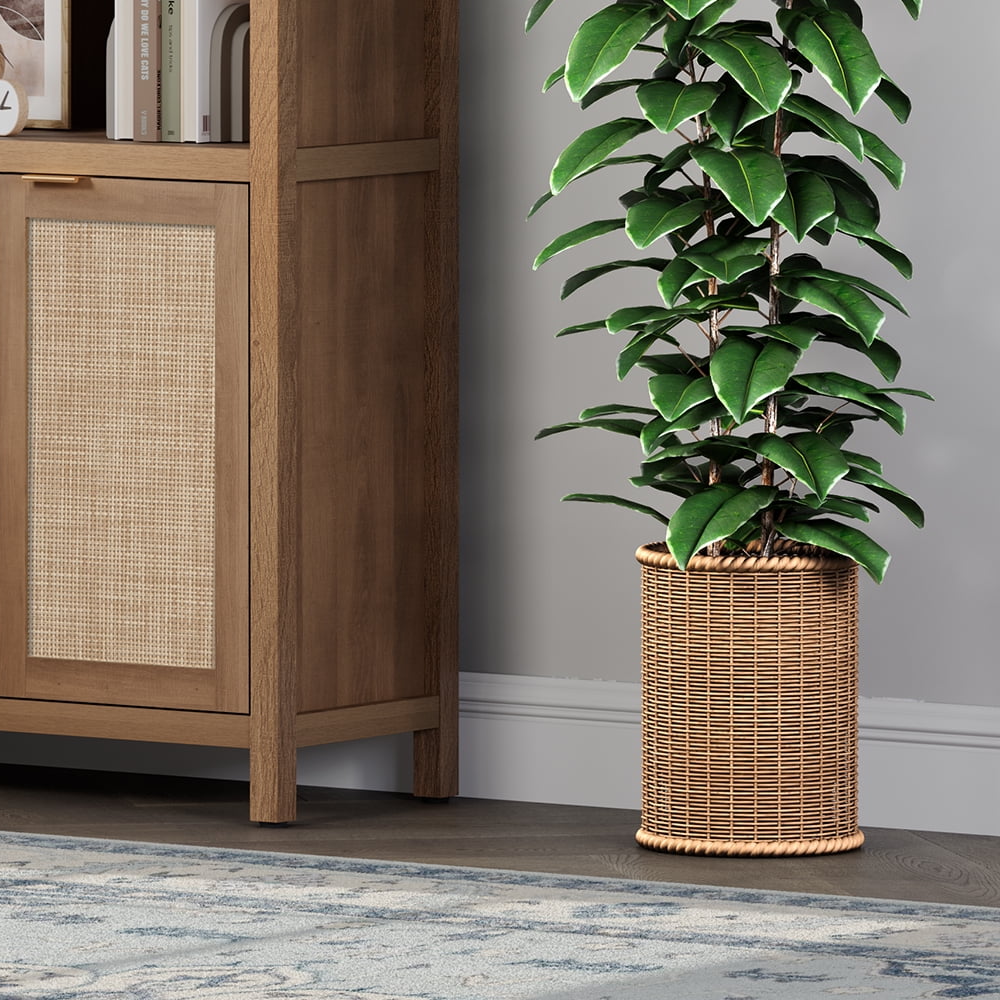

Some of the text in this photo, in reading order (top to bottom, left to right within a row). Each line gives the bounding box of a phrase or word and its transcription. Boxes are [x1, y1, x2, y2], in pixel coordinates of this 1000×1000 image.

[141, 10, 149, 22] DO
[141, 23, 149, 36] WE
[141, 38, 149, 58] LOVE
[141, 59, 149, 81] CATS
